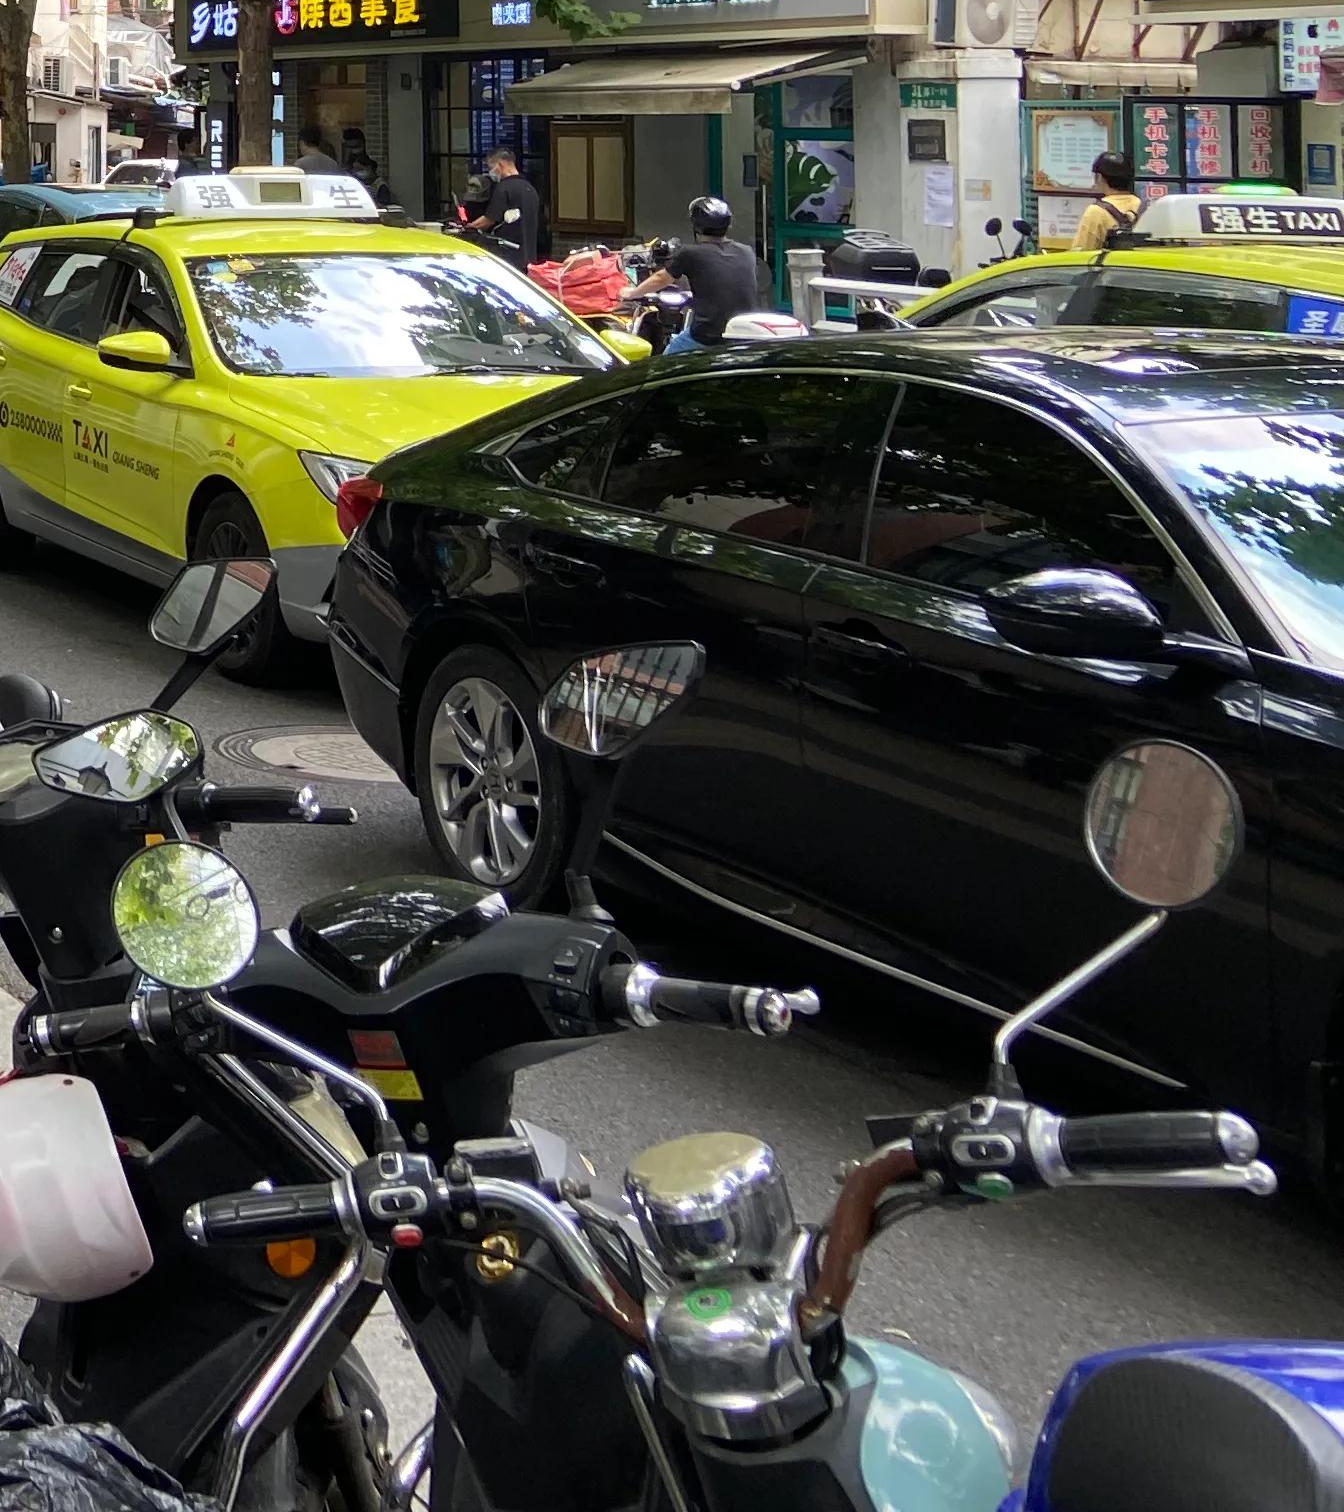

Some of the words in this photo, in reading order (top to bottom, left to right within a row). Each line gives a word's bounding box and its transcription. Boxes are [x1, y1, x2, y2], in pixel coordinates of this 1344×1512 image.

[1144, 106, 1169, 175] 手机卡号
[1198, 108, 1221, 175] 手机维修
[1250, 107, 1273, 174] 回收手机
[72, 419, 108, 460] TAXI
